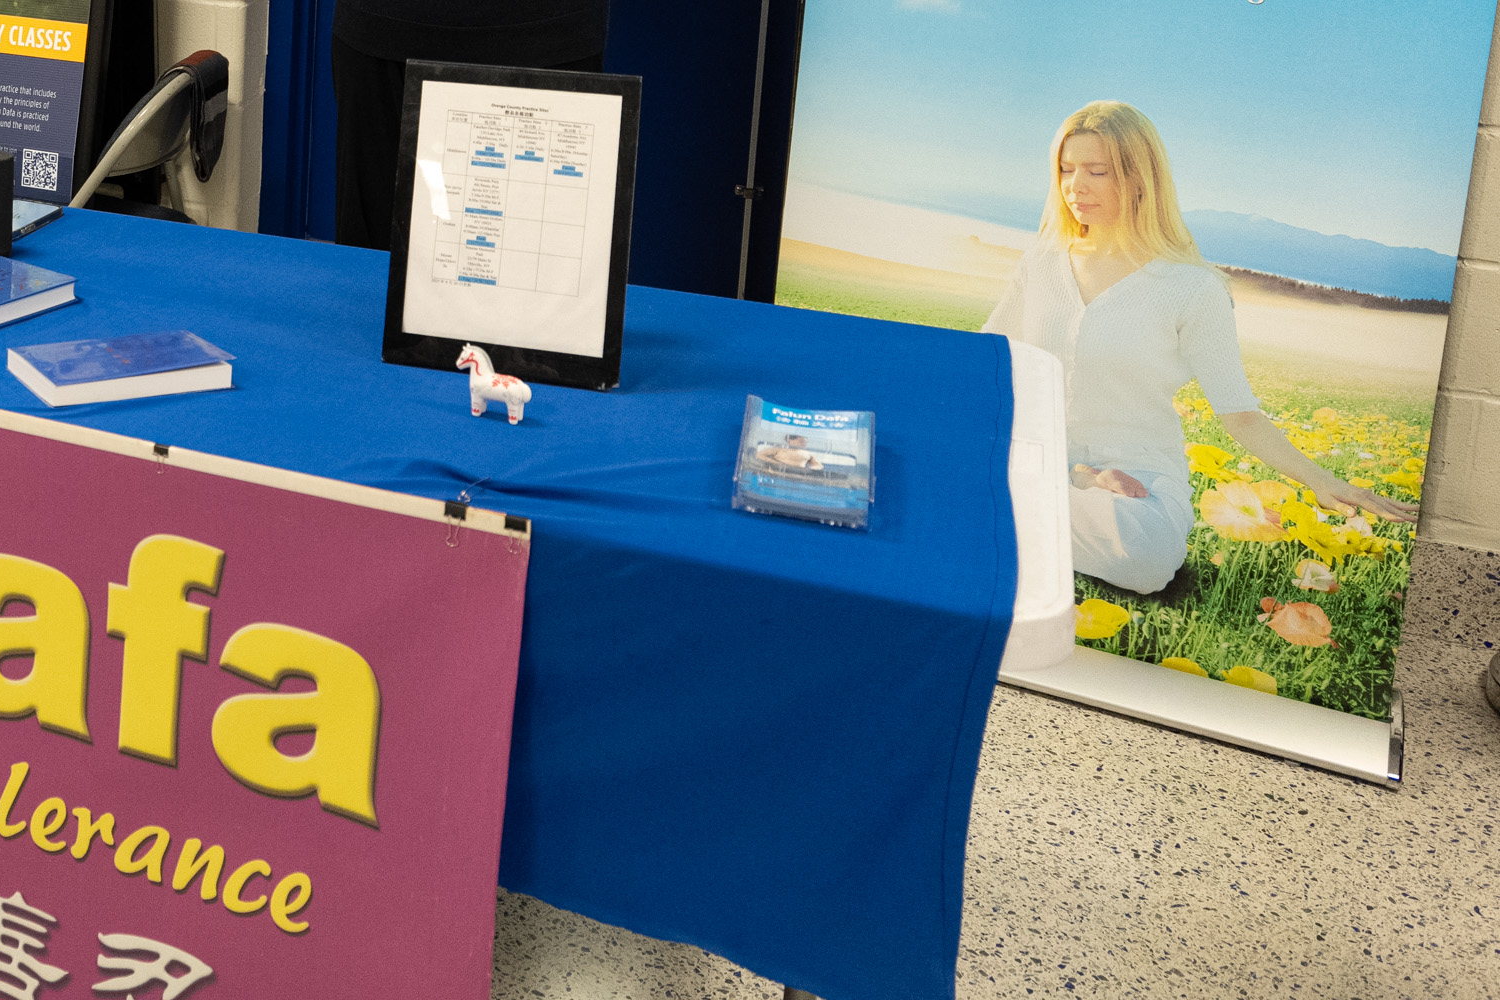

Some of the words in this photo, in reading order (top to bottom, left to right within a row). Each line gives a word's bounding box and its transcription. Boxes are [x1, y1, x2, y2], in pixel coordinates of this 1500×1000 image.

[8, 25, 72, 52] CLASSES
[20, 87, 32, 95] that
[33, 88, 56, 98] includes
[3, 96, 13, 105] the
[14, 98, 41, 109] principles
[2, 108, 15, 117] Dafa
[22, 112, 49, 121] practiced
[12, 121, 22, 129] the
[24, 123, 41, 132] world.
[772, 407, 812, 420] Falun
[814, 414, 849, 422] Dafa
